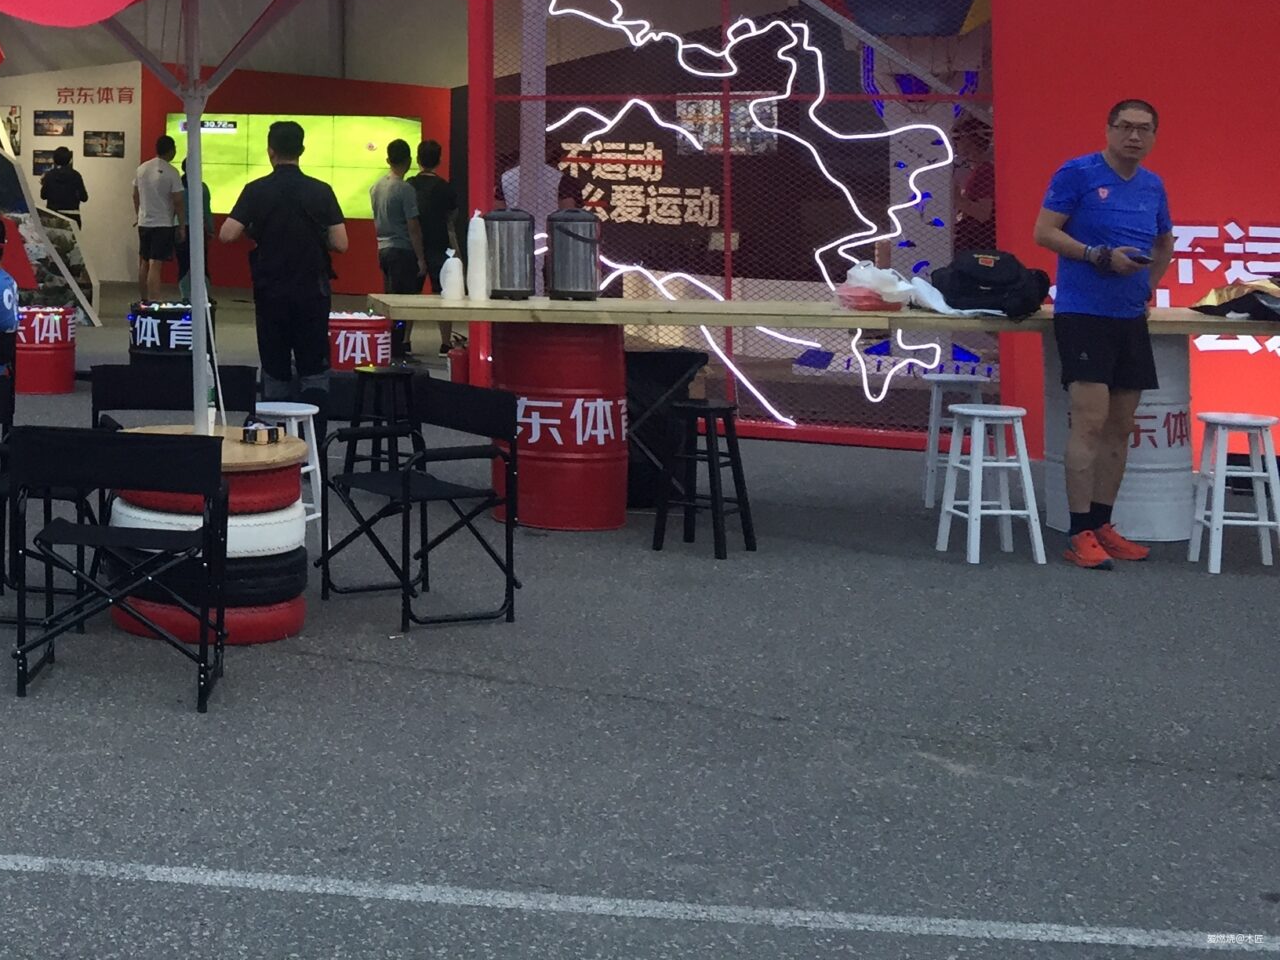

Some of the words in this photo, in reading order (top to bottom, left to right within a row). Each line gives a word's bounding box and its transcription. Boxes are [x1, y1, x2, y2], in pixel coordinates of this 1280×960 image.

[56, 86, 135, 105] 京东体育
[557, 140, 664, 182] 不运动
[129, 314, 192, 350] 体育
[328, 330, 391, 365] 体育
[517, 397, 628, 445] 东体
